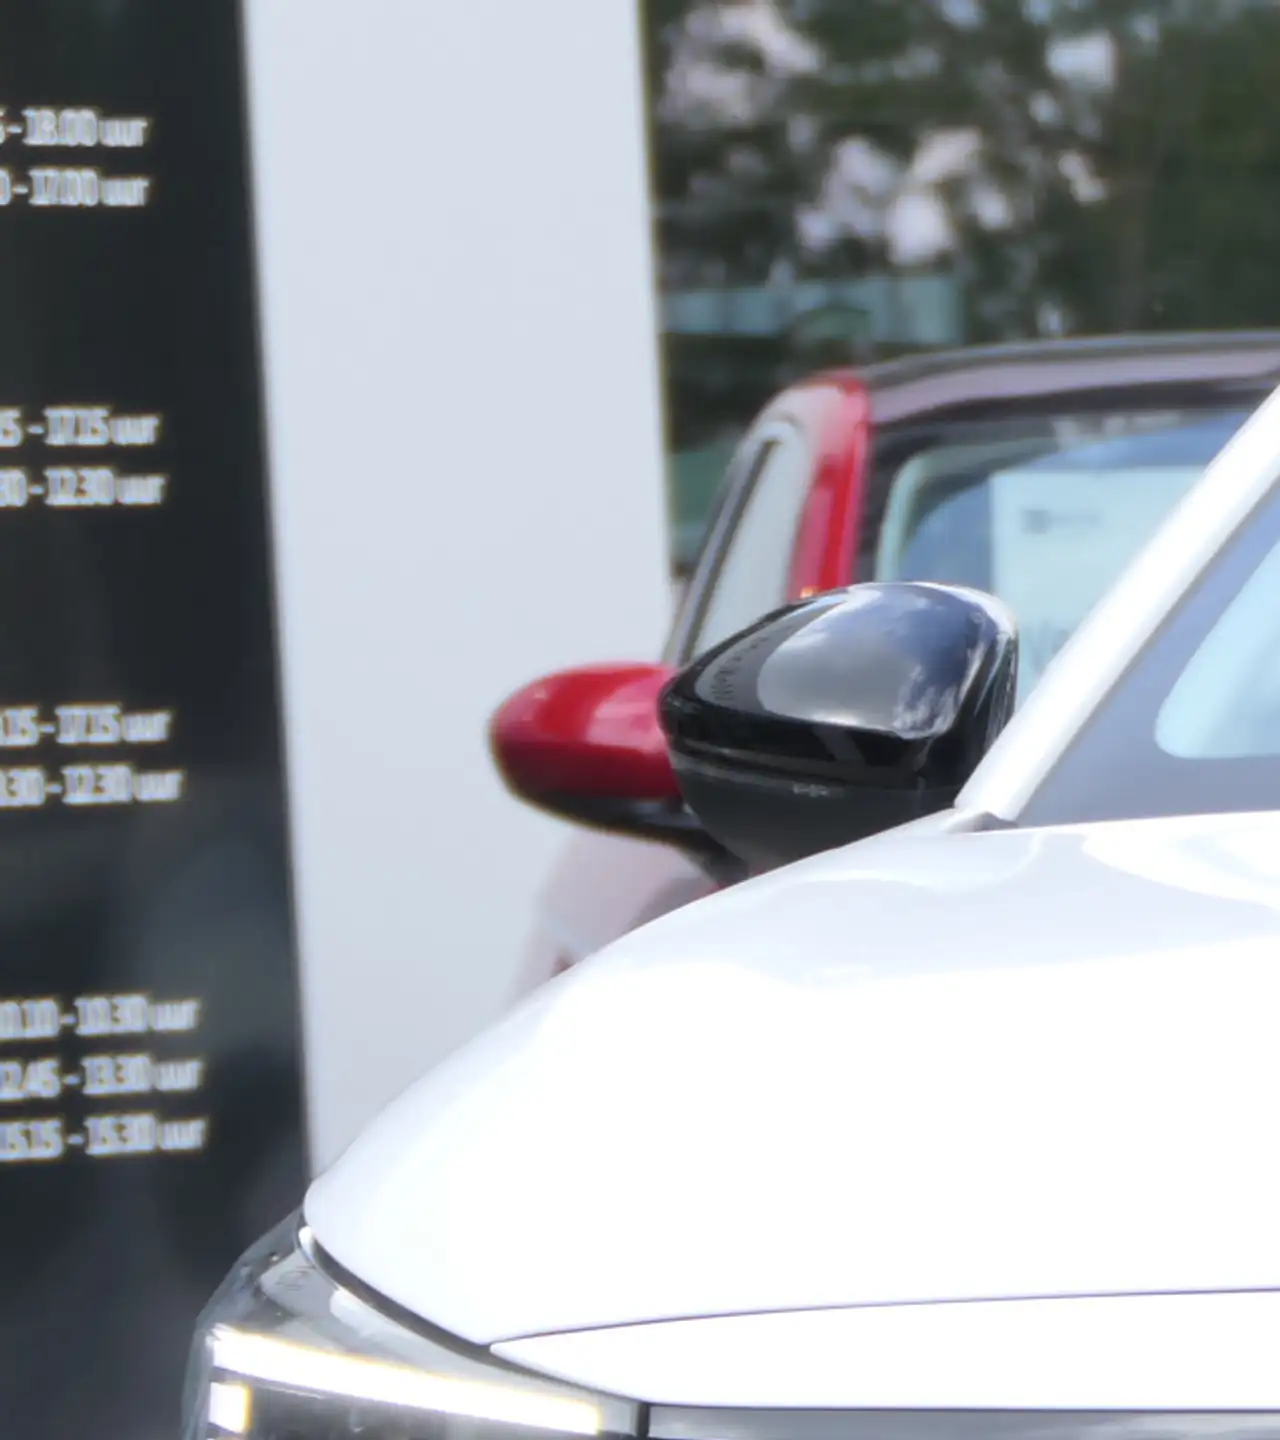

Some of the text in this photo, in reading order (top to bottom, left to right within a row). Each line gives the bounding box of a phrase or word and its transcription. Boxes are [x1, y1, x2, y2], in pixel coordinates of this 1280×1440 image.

[98, 118, 148, 147] uur
[99, 178, 148, 206] uur
[110, 416, 159, 446] uur
[116, 475, 165, 505] uur
[121, 712, 170, 743] uur
[132, 771, 182, 802] uur
[149, 999, 199, 1031] uur
[152, 1059, 202, 1091] uur
[157, 1119, 206, 1151] uur
